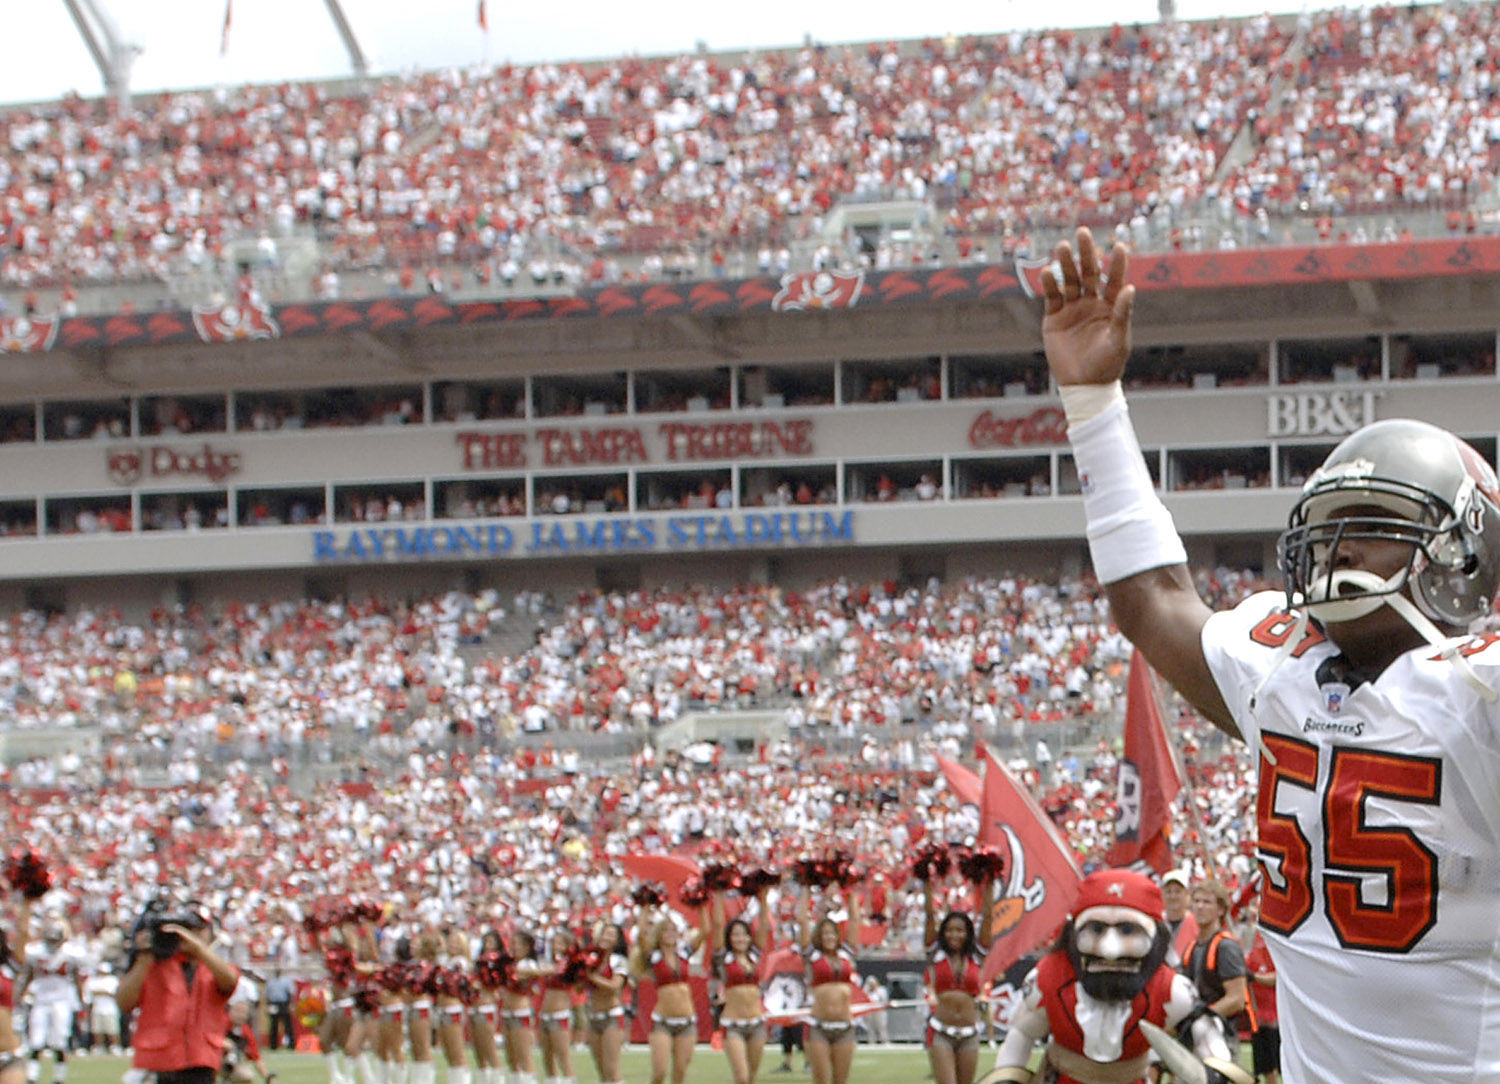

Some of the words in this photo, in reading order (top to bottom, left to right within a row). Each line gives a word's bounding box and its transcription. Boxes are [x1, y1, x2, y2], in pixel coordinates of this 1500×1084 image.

[968, 406, 1069, 448] Coca-Col
[1266, 388, 1388, 436] BB&T
[150, 443, 242, 482] Dodge
[455, 432, 527, 469] THE
[535, 427, 648, 467] TAMPA
[659, 419, 814, 462] TRIBUNE
[313, 524, 514, 560] RAYMOND
[526, 517, 655, 551] JAMES
[667, 511, 854, 546] STADIUM
[1257, 729, 1442, 954] 55
